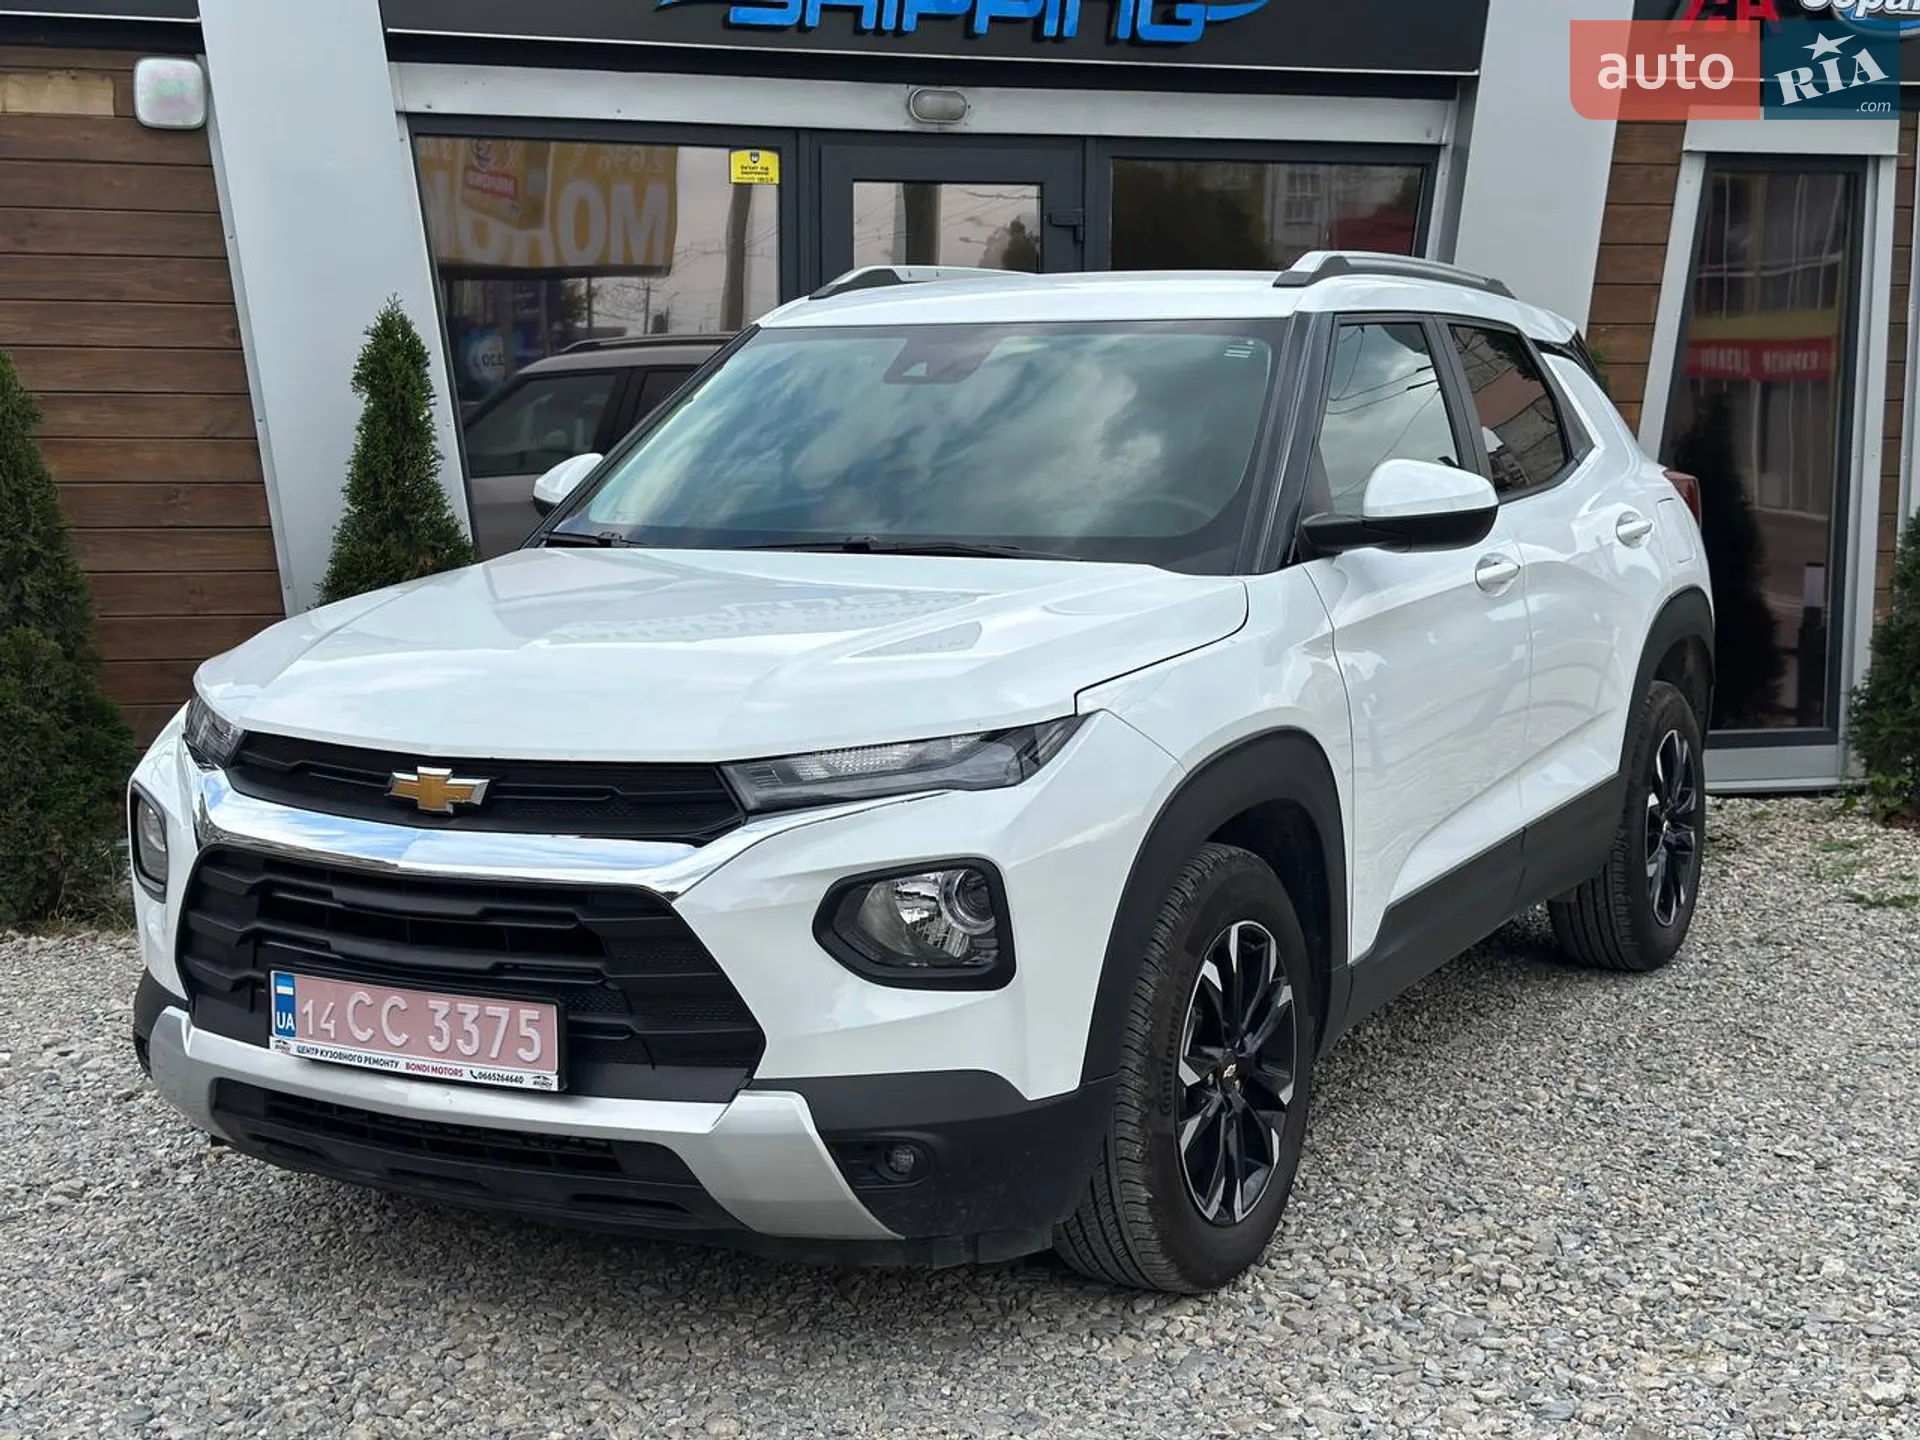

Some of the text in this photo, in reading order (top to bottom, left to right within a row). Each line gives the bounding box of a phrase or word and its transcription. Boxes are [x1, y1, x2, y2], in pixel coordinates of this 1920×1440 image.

[276, 1011, 296, 1031] UA
[427, 999, 542, 1063] 3375
[296, 1044, 319, 1056] ЦЕНТР
[319, 1048, 363, 1063] КУЗОВНОГО
[363, 1057, 401, 1069] РЕМОНТУ
[404, 1062, 430, 1074] BONDI
[431, 1065, 464, 1078] MOTORS
